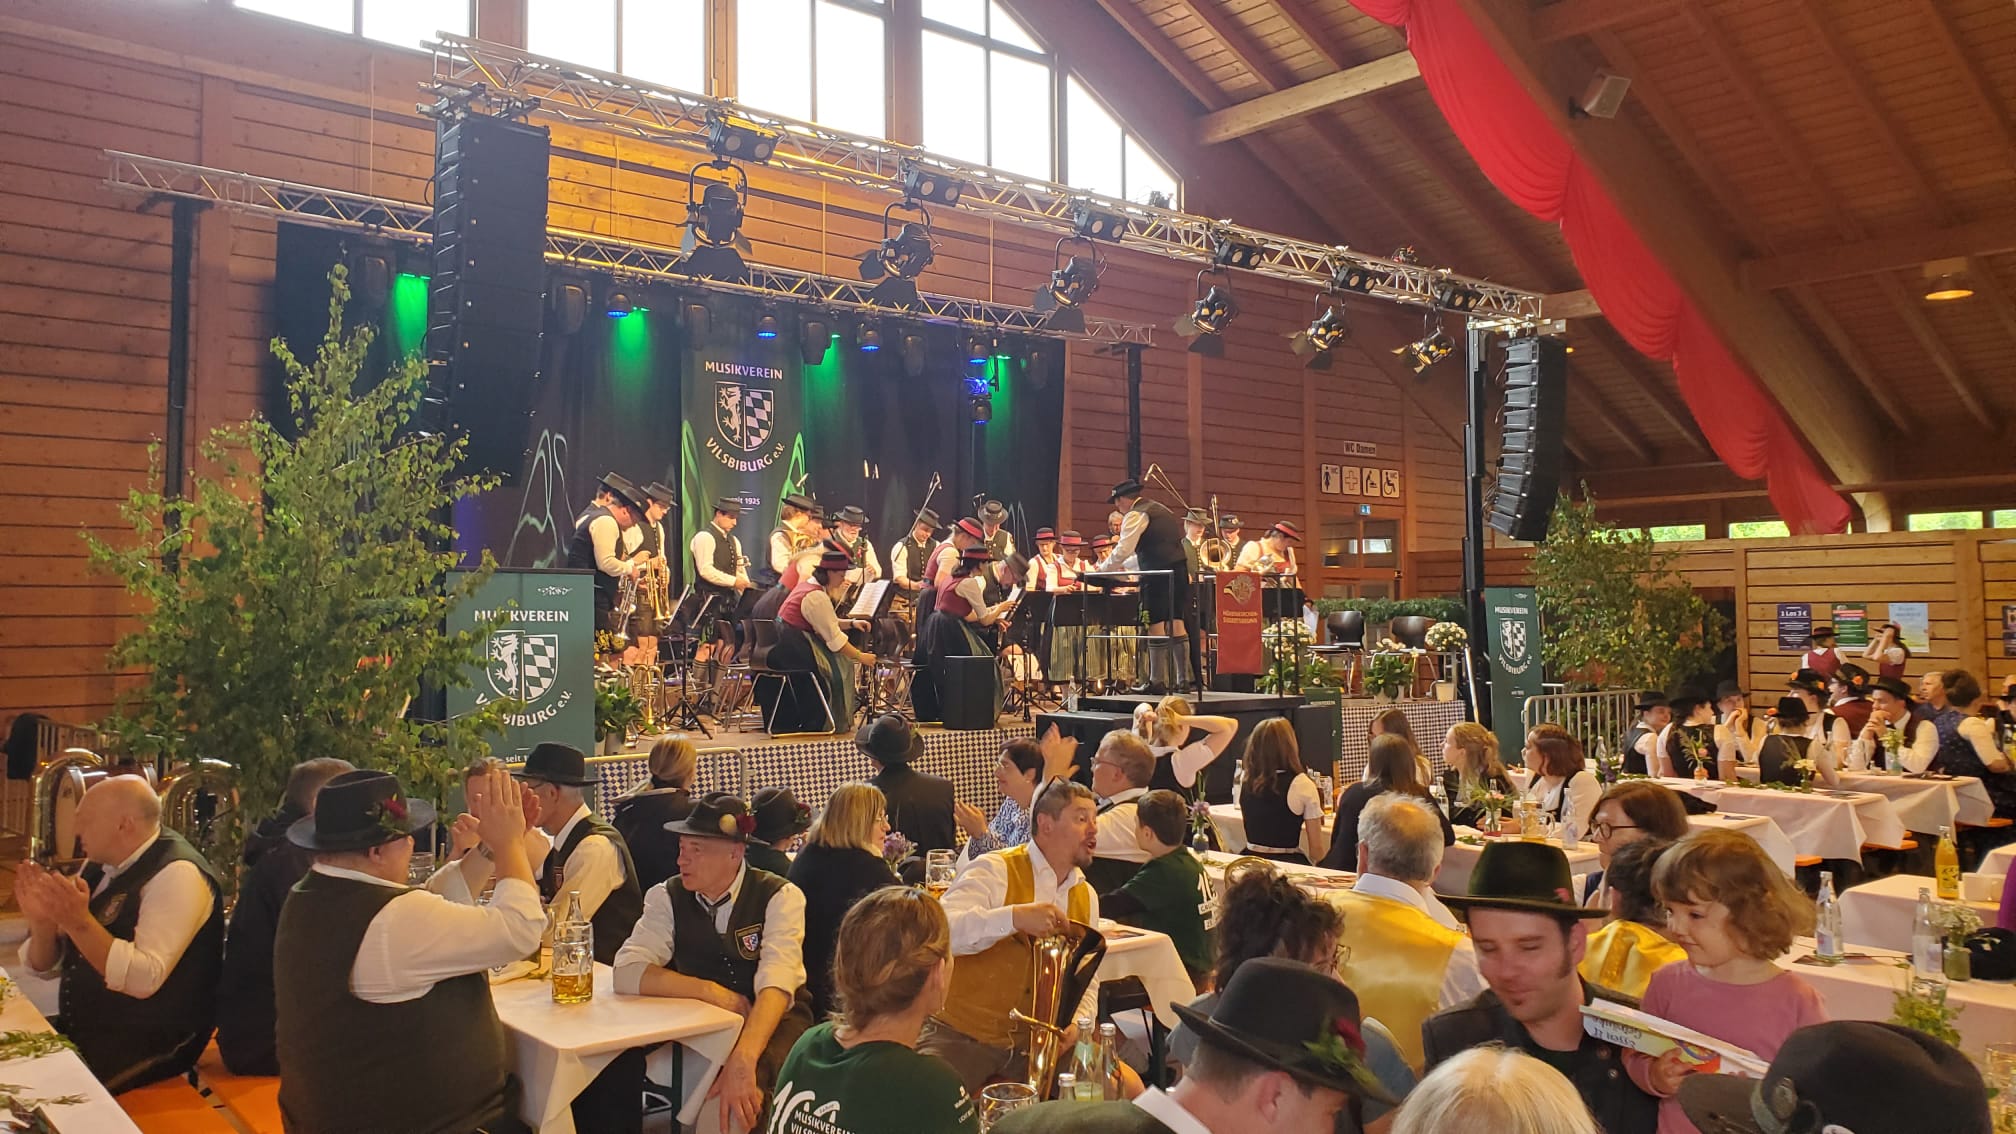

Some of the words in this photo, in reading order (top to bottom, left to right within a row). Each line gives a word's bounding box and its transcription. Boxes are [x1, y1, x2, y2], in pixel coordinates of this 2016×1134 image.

[705, 361, 783, 380] MUSIKVEREIN
[1345, 442, 1355, 453] WC
[705, 437, 773, 472] VILSBIBURG
[773, 442, 785, 459] e.V.
[745, 497, 761, 506] 1925
[474, 610, 569, 622] MUKVEREIN
[557, 690, 572, 708] e.V.
[505, 754, 521, 763] seit
